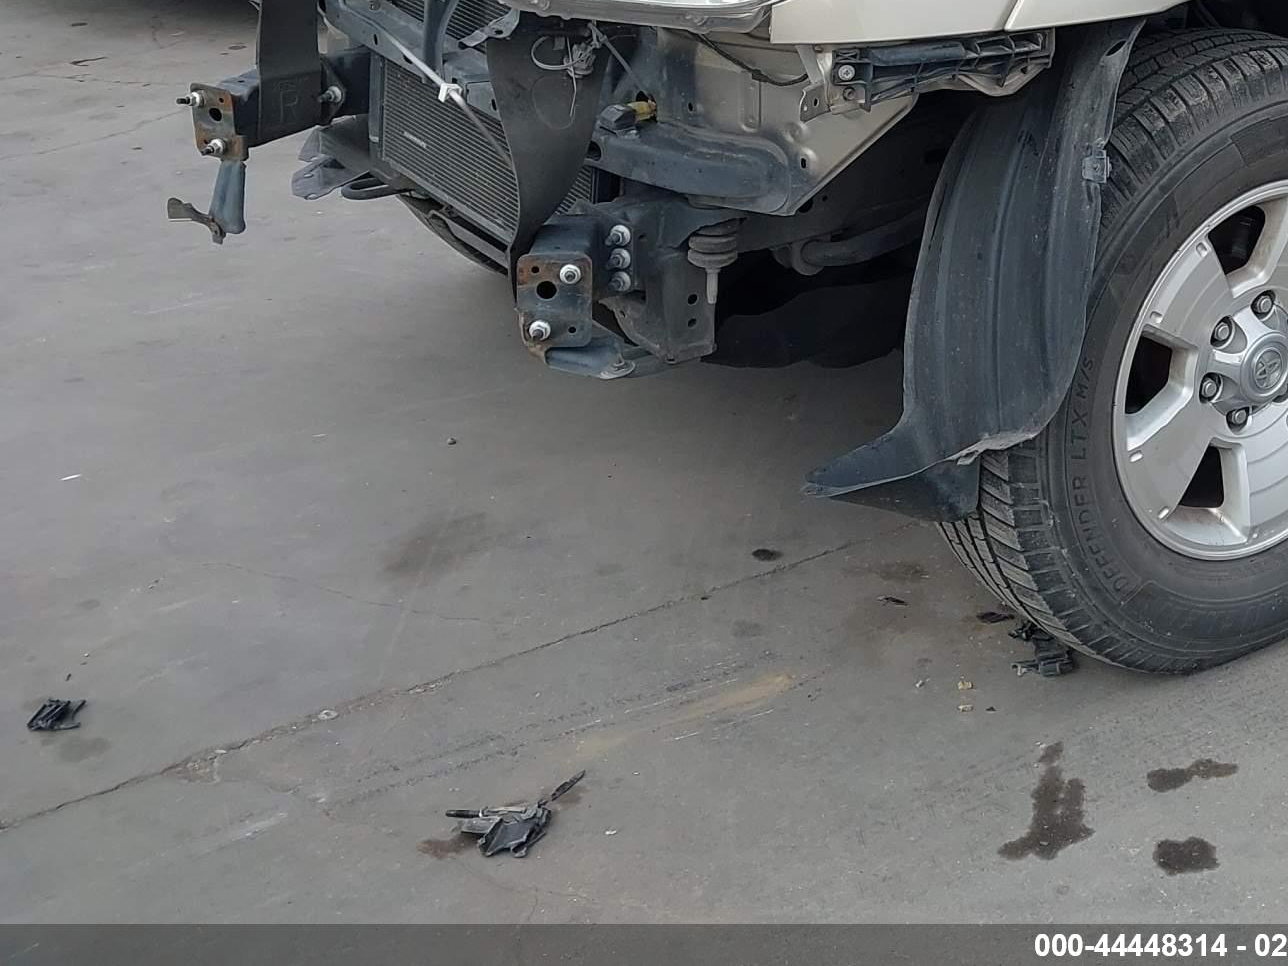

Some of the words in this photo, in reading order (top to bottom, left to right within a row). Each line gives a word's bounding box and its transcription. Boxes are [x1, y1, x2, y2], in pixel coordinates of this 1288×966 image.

[1074, 357, 1096, 400] M/S
[1070, 408, 1089, 461] LTX
[1071, 475, 1129, 593] DEFENDER
